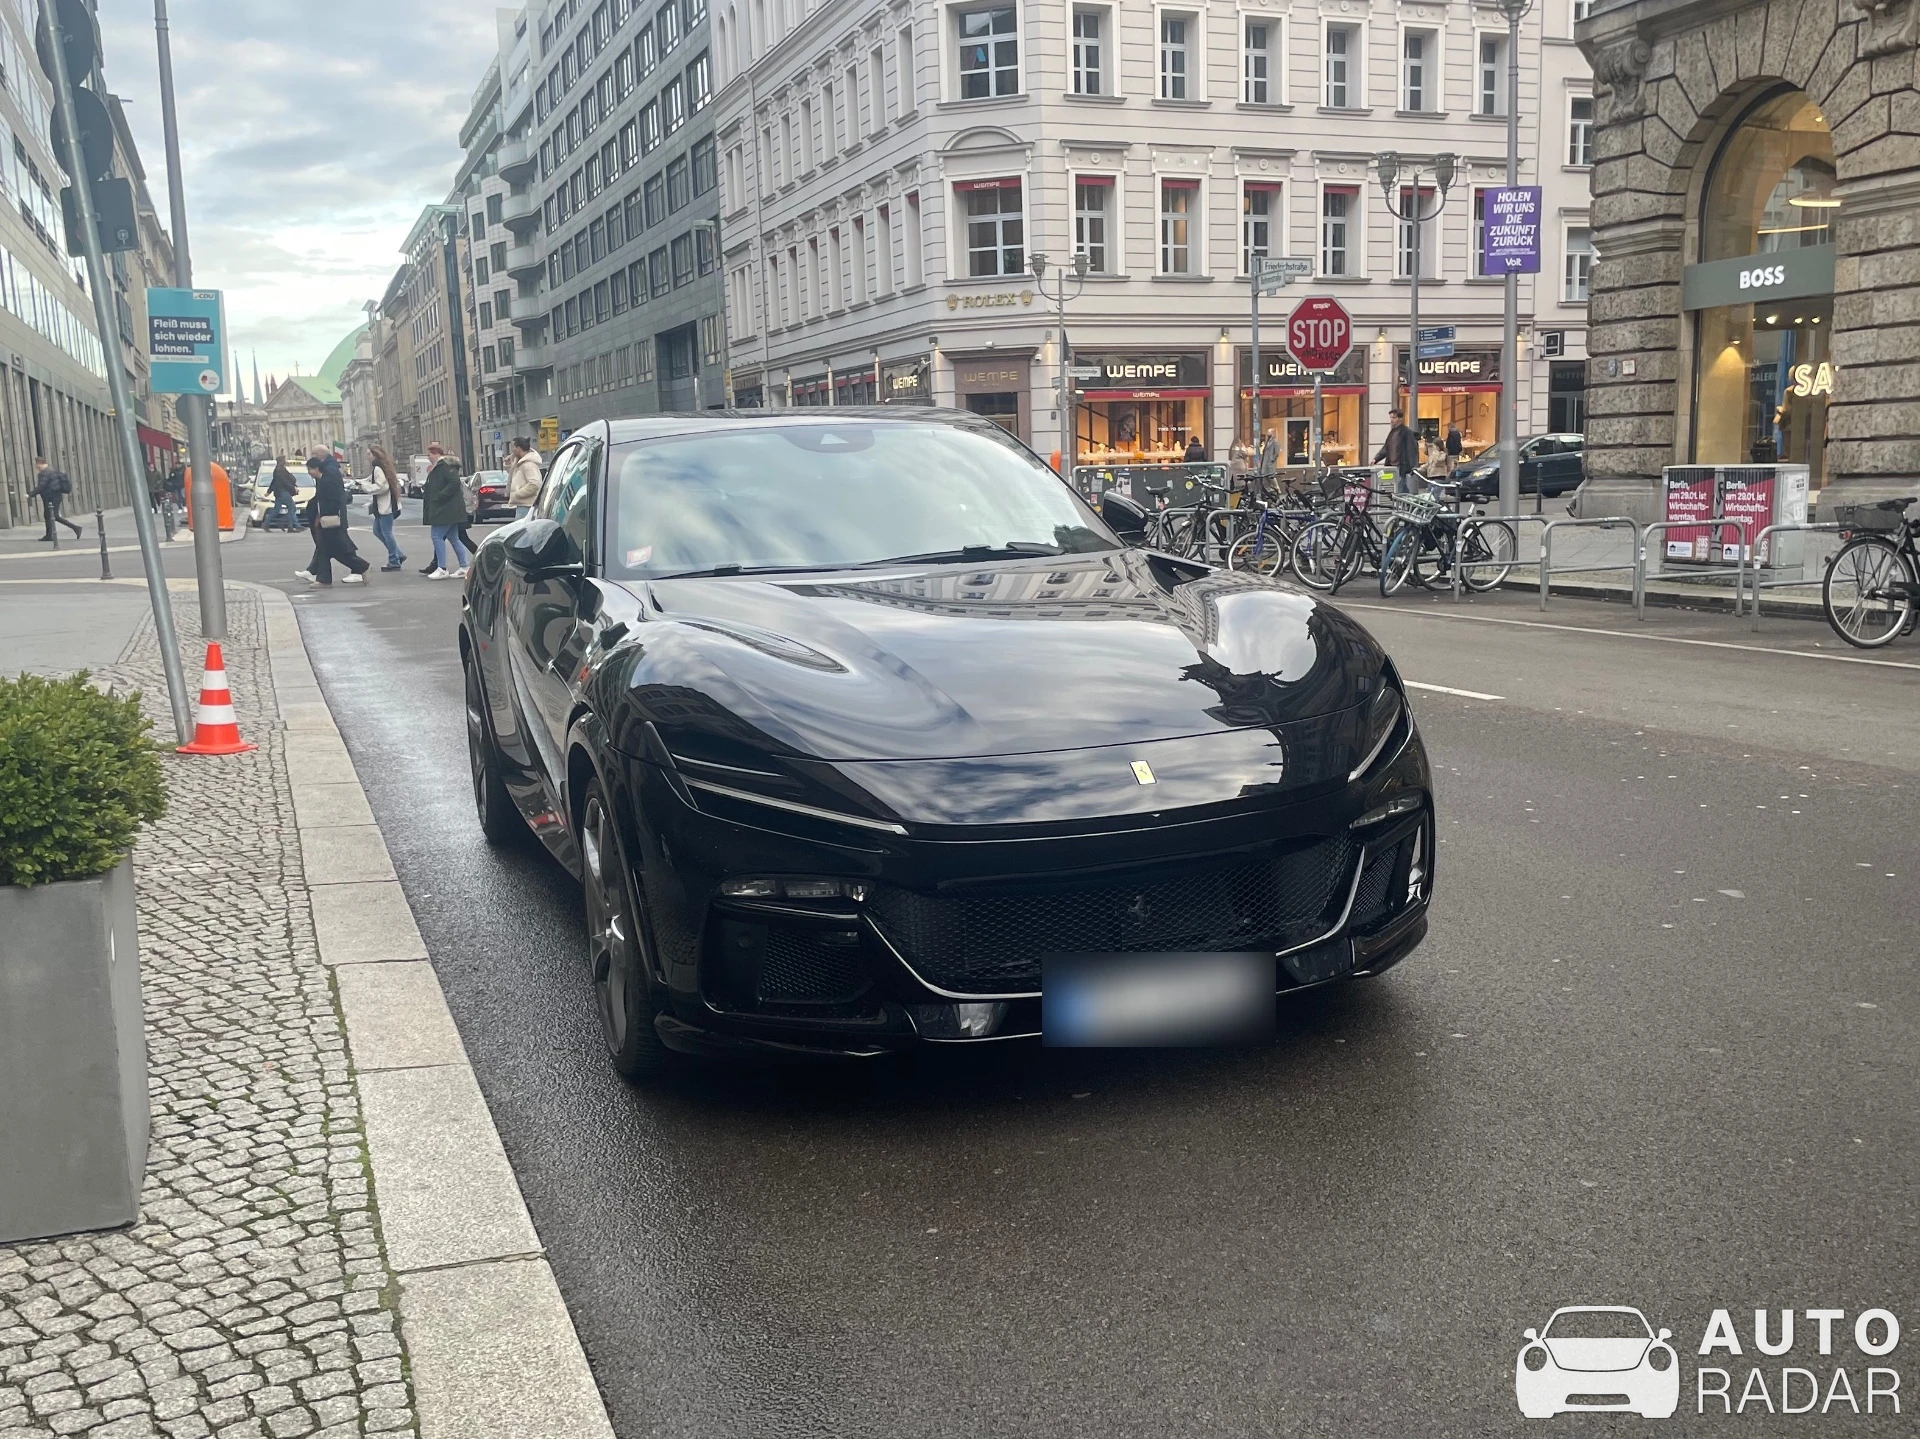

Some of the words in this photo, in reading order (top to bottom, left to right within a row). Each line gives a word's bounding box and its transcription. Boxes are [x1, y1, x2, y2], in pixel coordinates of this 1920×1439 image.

[973, 181, 1000, 189] WEMPE
[1497, 191, 1532, 203] HOLEN
[1493, 203, 1514, 214] WIR
[1515, 202, 1535, 213] UNS
[1505, 213, 1523, 224] DIE
[1489, 224, 1537, 236] ZUKUNFT
[1492, 234, 1534, 246] ZURÜCK
[1505, 257, 1523, 267] Volt
[1739, 265, 1785, 290] BOSS
[963, 293, 1017, 309] ROLEX
[153, 319, 179, 329] Fleiß
[180, 321, 208, 329] muss
[154, 331, 176, 341] sich
[177, 332, 212, 342] wieder
[1293, 318, 1347, 349] STOP
[154, 343, 192, 353] lohnen.
[1106, 364, 1177, 378] WEMPE
[1418, 361, 1481, 374] WEMPE
[892, 374, 919, 390] WEMPE
[963, 370, 1018, 383] WEMPE
[1793, 361, 1840, 396] SA
[1669, 480, 1691, 490] Berlin,
[1726, 481, 1747, 491] Berlin,
[1699, 492, 1707, 500] ist
[1757, 492, 1766, 501] ist
[1668, 502, 1710, 511] Wirtschafts-
[1725, 503, 1769, 512] Wirtschafts-
